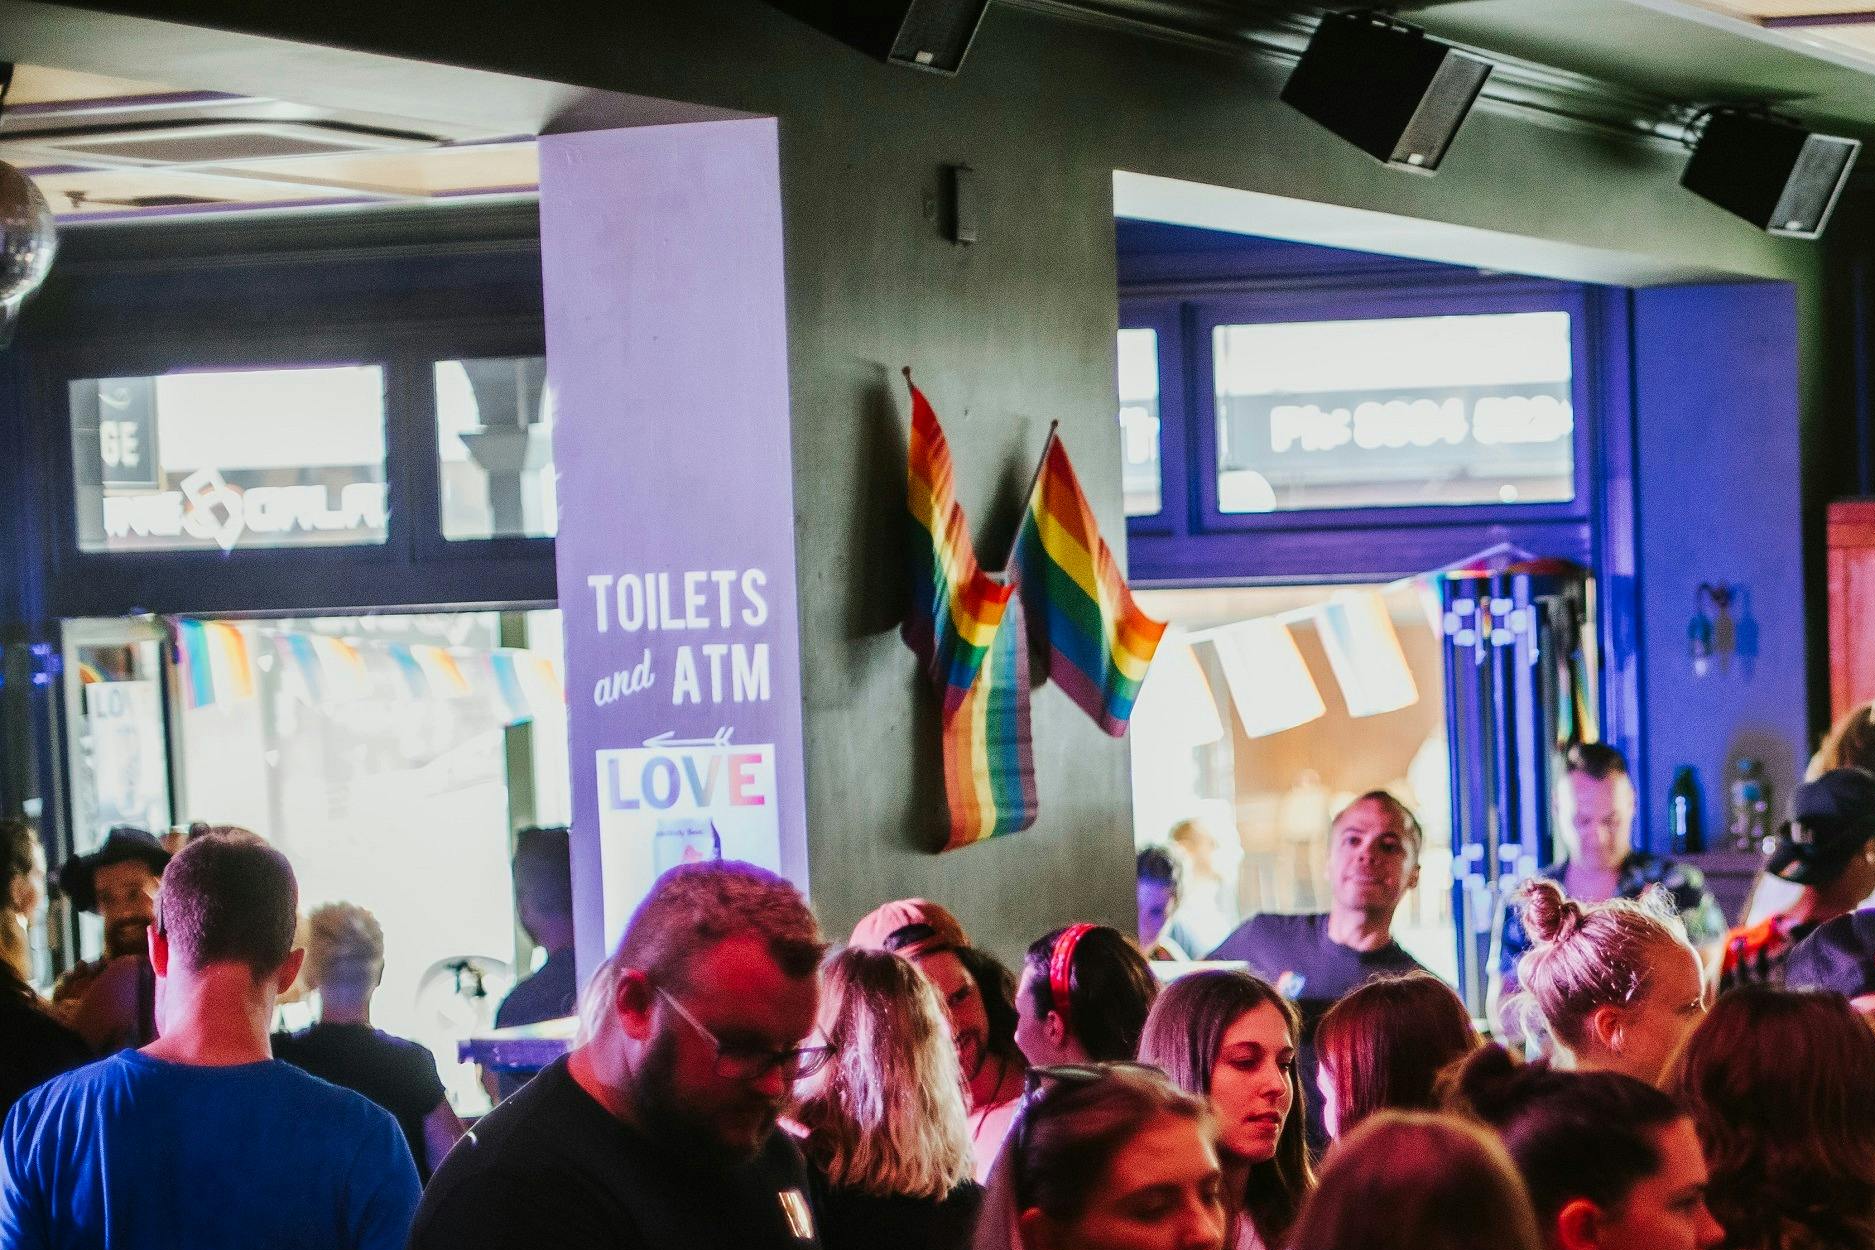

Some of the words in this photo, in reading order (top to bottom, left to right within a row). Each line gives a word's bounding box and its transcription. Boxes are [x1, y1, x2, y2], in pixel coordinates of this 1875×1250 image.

[587, 568, 769, 633] TOILETS
[594, 647, 655, 707] and
[672, 643, 771, 705] ATM
[607, 752, 766, 811] LOVE
